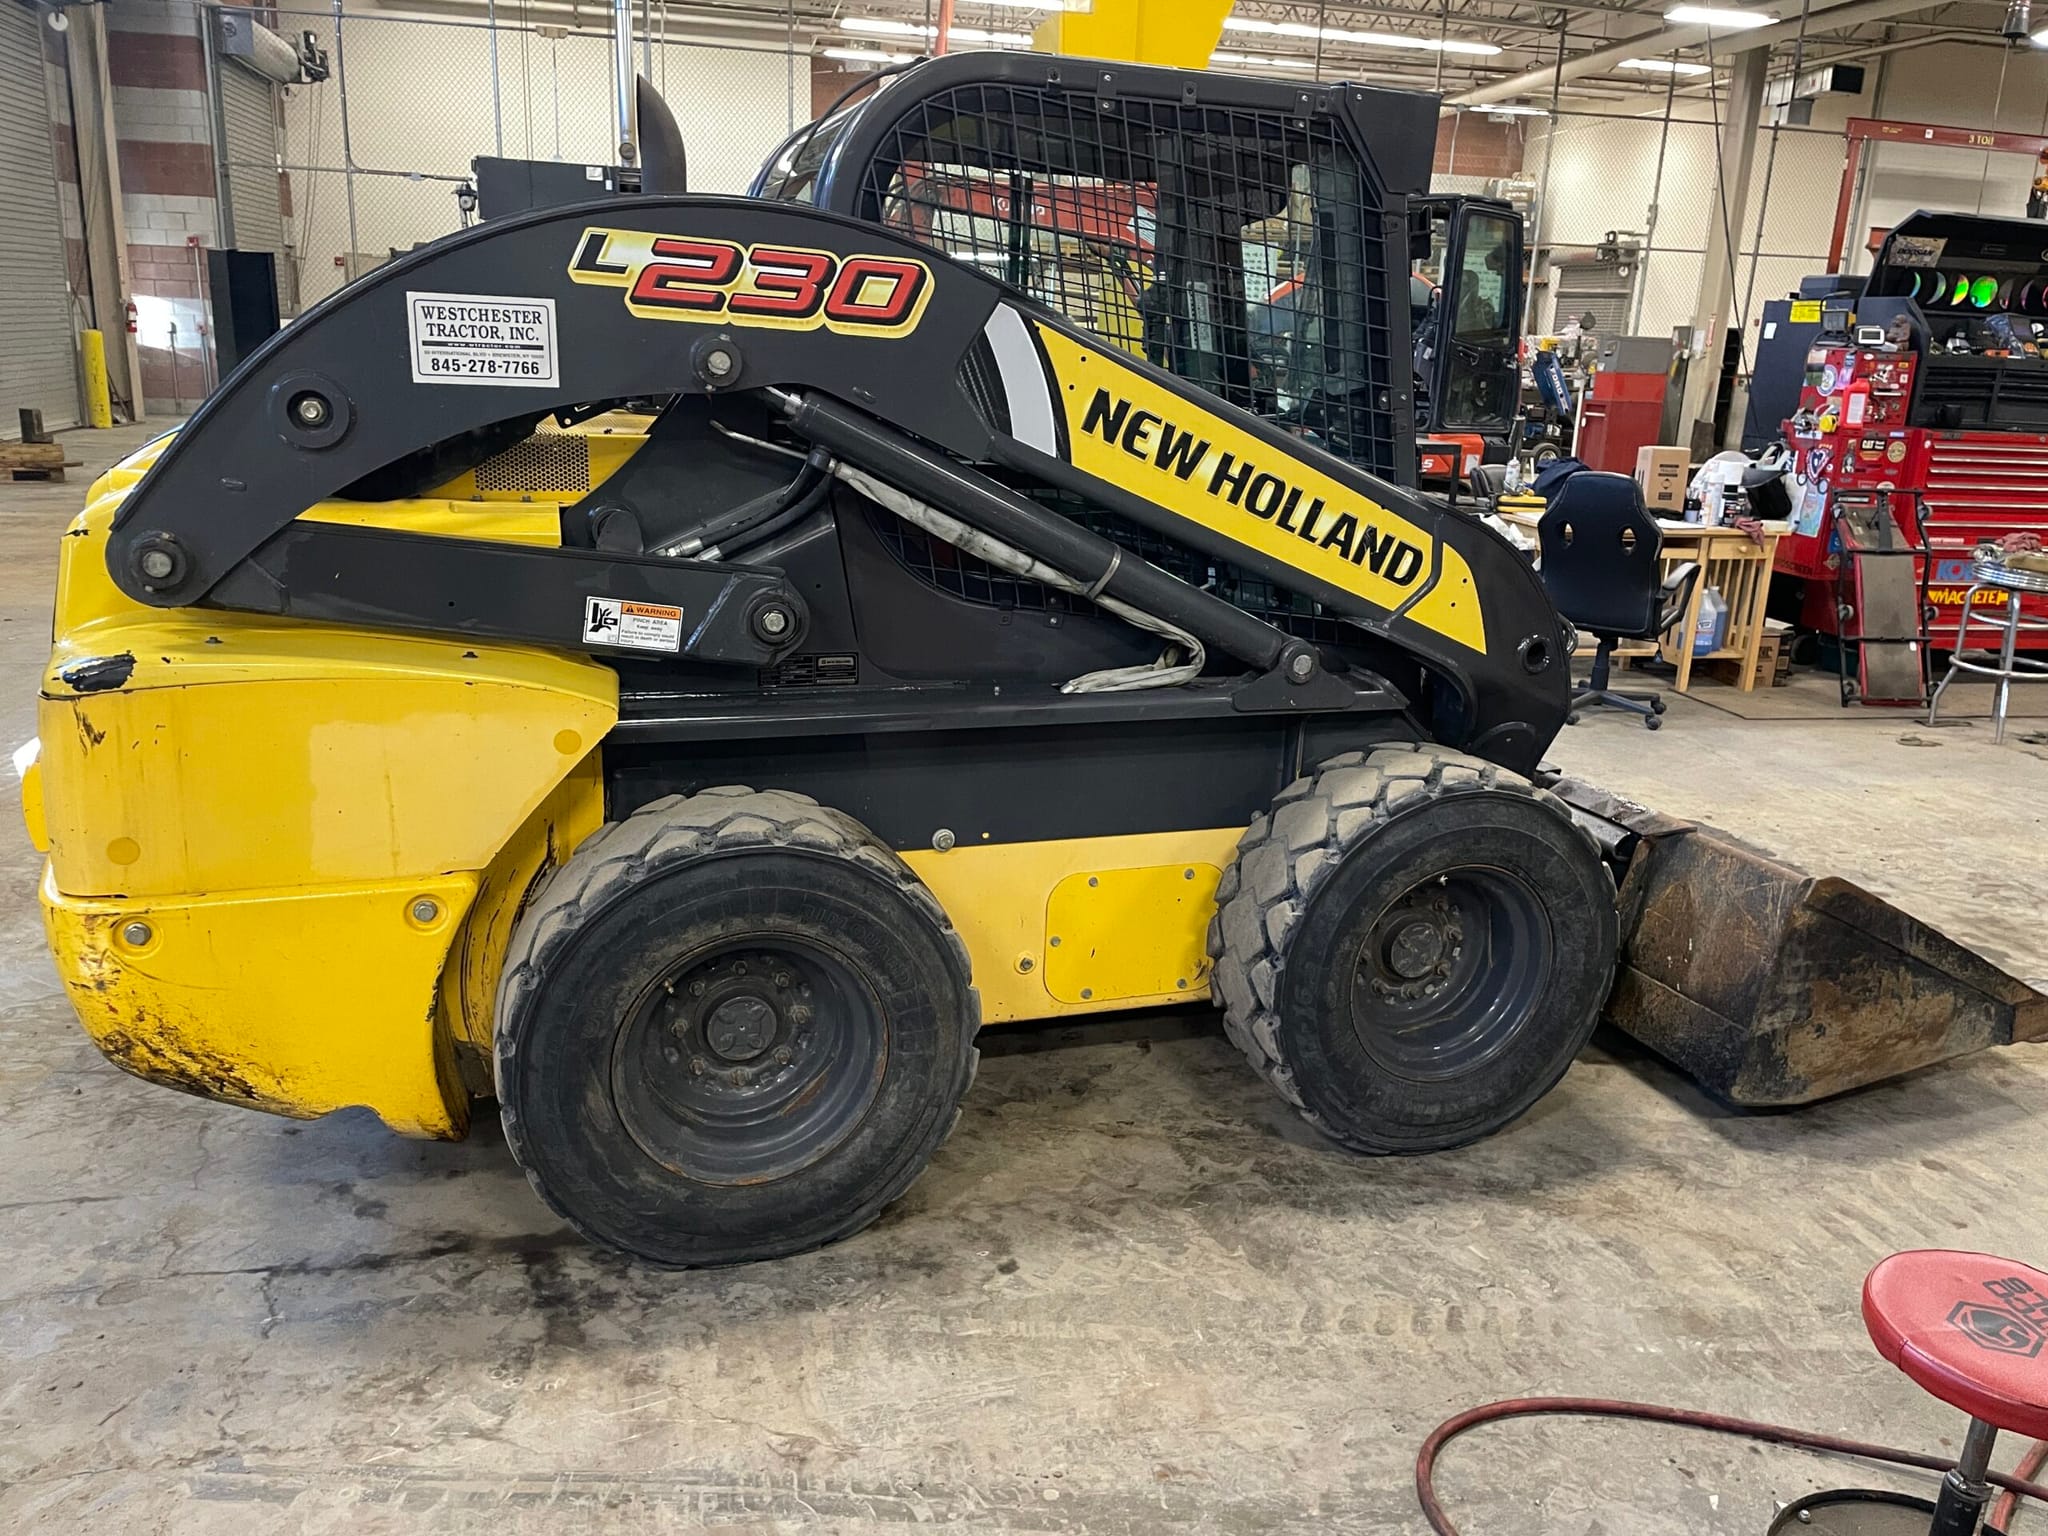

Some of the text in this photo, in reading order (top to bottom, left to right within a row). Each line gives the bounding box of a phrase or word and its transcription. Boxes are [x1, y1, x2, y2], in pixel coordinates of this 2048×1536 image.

[571, 229, 932, 333] L230
[421, 305, 543, 324] WESTCHESTER
[426, 323, 539, 341] TRACTOR, INC.
[431, 358, 540, 374] 845-278-7766
[1080, 387, 1424, 587] NEW HOLLAND
[636, 607, 677, 617] WARNING
